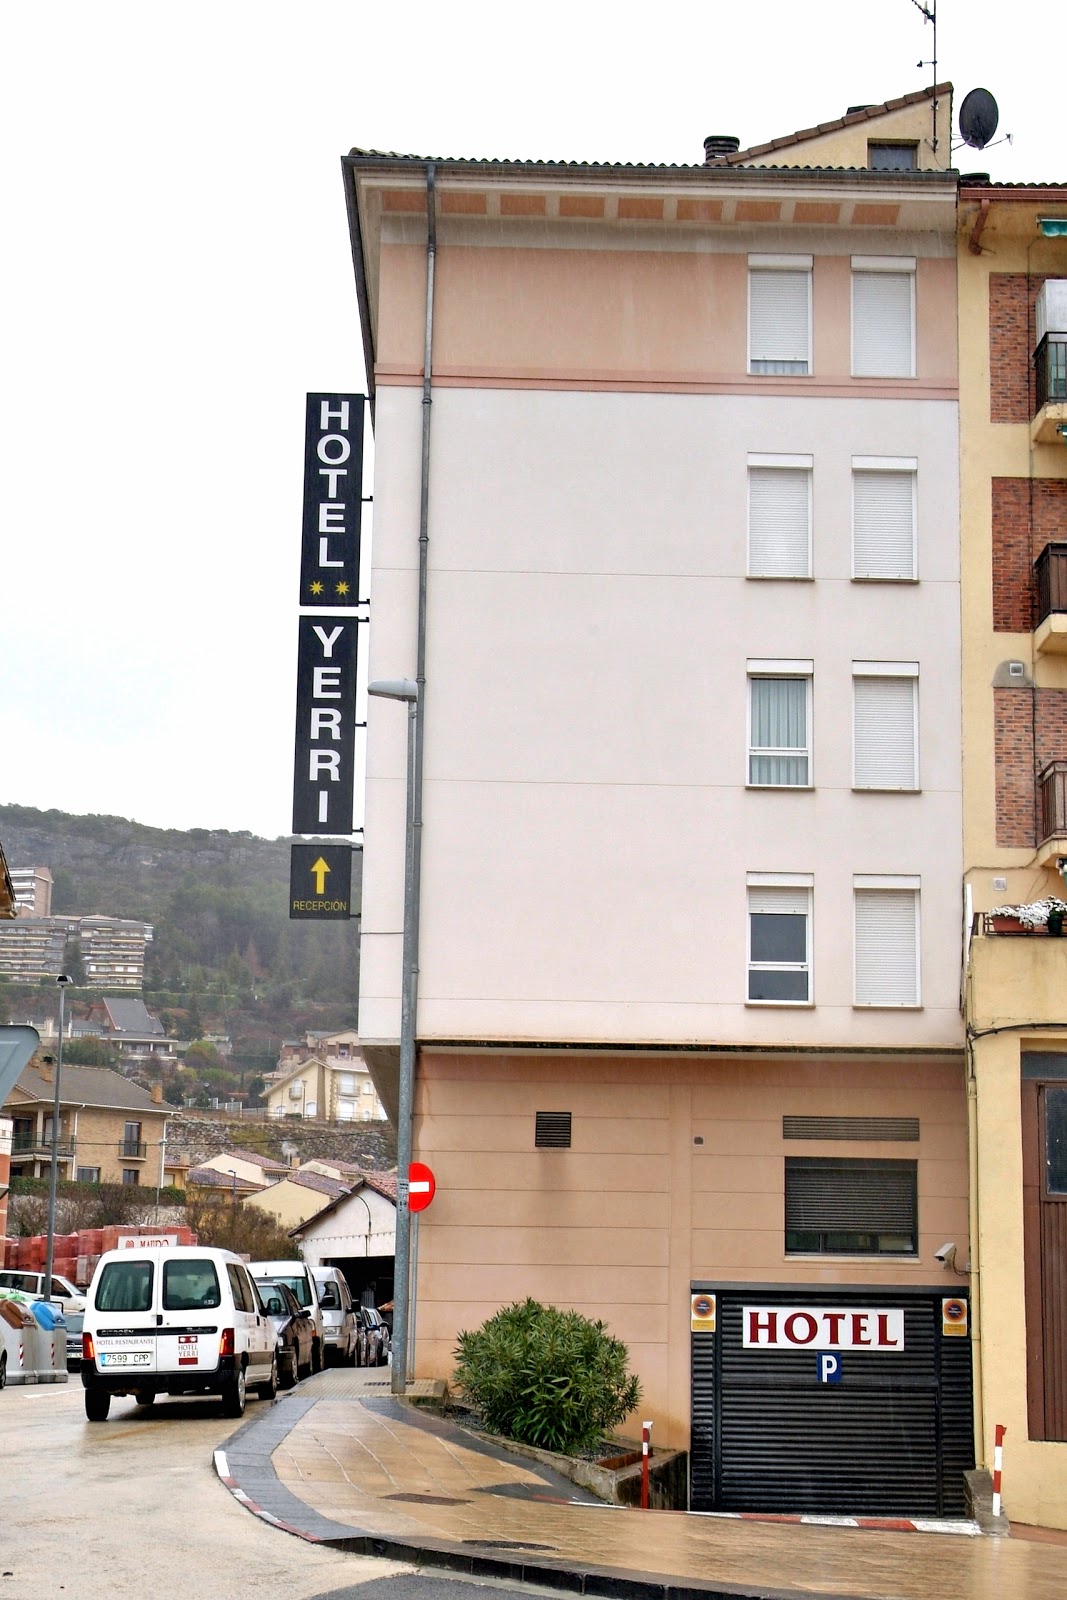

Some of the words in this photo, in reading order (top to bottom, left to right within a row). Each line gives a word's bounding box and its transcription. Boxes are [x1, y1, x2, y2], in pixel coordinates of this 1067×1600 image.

[316, 400, 351, 569] HOTEL
[309, 626, 344, 823] YERRI
[293, 899, 347, 911] RECEPCIÓN
[749, 1312, 898, 1346] HOTEL
[107, 1354, 128, 1363] 7599
[822, 1354, 837, 1383] P
